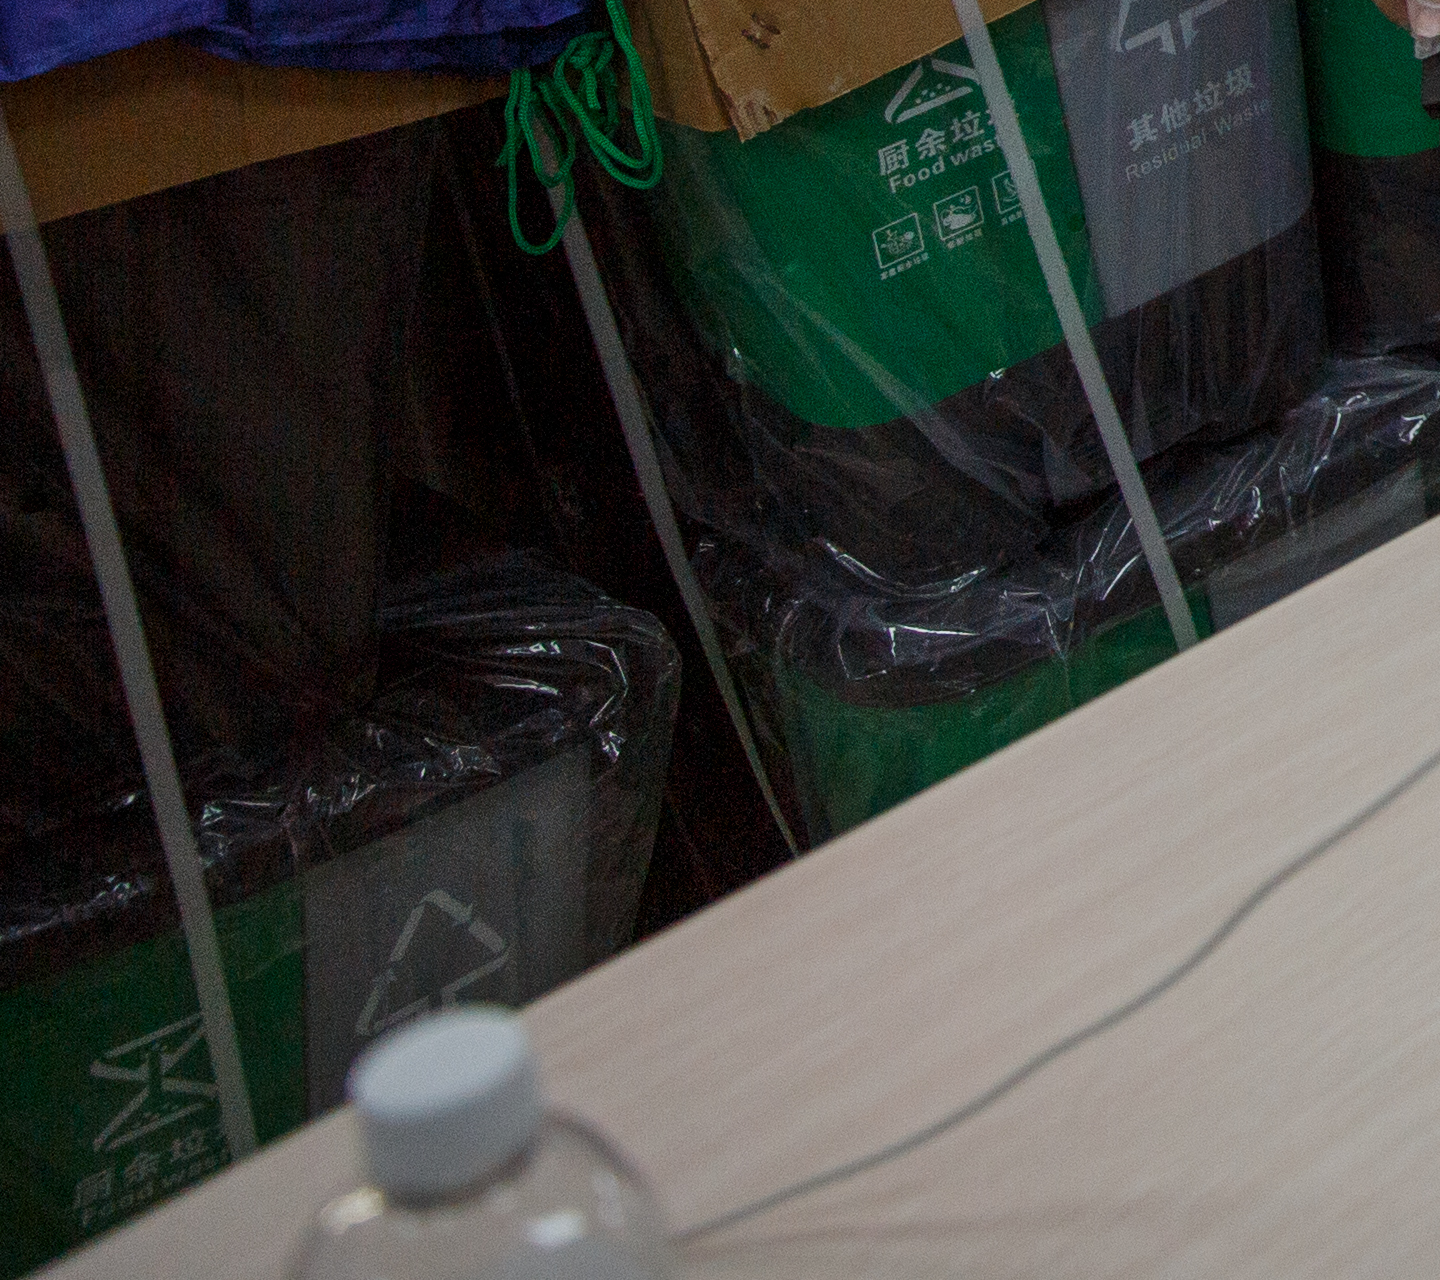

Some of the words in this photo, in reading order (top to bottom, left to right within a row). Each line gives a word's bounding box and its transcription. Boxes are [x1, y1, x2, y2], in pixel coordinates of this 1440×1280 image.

[878, 108, 994, 177] 厨余垃
[1125, 131, 1210, 183] Residual
[1213, 97, 1272, 145] Waste
[1126, 63, 1256, 153] 其他垃圾
[889, 155, 947, 194] Food
